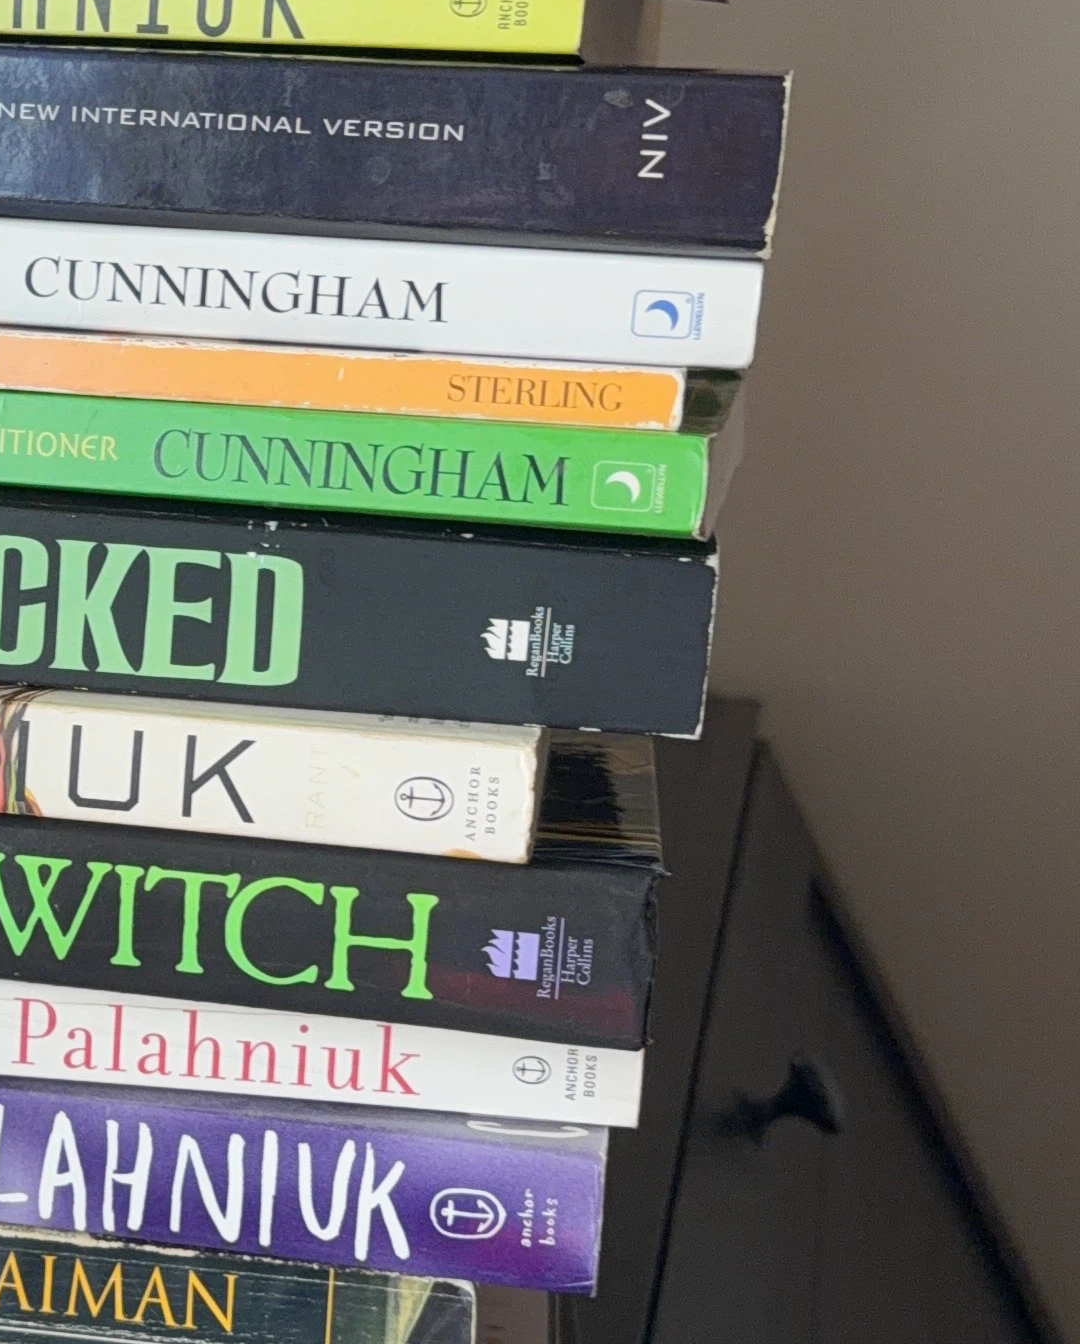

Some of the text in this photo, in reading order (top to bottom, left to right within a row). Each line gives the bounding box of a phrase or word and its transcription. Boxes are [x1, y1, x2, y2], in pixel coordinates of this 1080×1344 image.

[72, 105, 311, 135] INTERNATIONAL
[323, 118, 465, 142] VERSION
[637, 98, 671, 179] NIV
[24, 256, 449, 323] CUNNINGHAM
[693, 292, 705, 341] LLEWELLYN
[447, 374, 623, 411] STERLING
[153, 429, 570, 506] CUNNINGHAM
[525, 606, 545, 677] ReganBooks
[546, 622, 563, 663] Harper
[559, 624, 575, 665] Collins
[465, 766, 482, 842] ANCHOR
[485, 776, 500, 835] BOOKS
[537, 916, 557, 999] ReganBooks
[561, 936, 578, 984] Harper
[576, 938, 595, 985] Collins
[11, 997, 420, 1096] Palahniuk
[565, 1048, 580, 1101] ANCHOR
[583, 1054, 598, 1097] BOOKS
[517, 1188, 534, 1248] anchor
[539, 1197, 558, 1247] books
